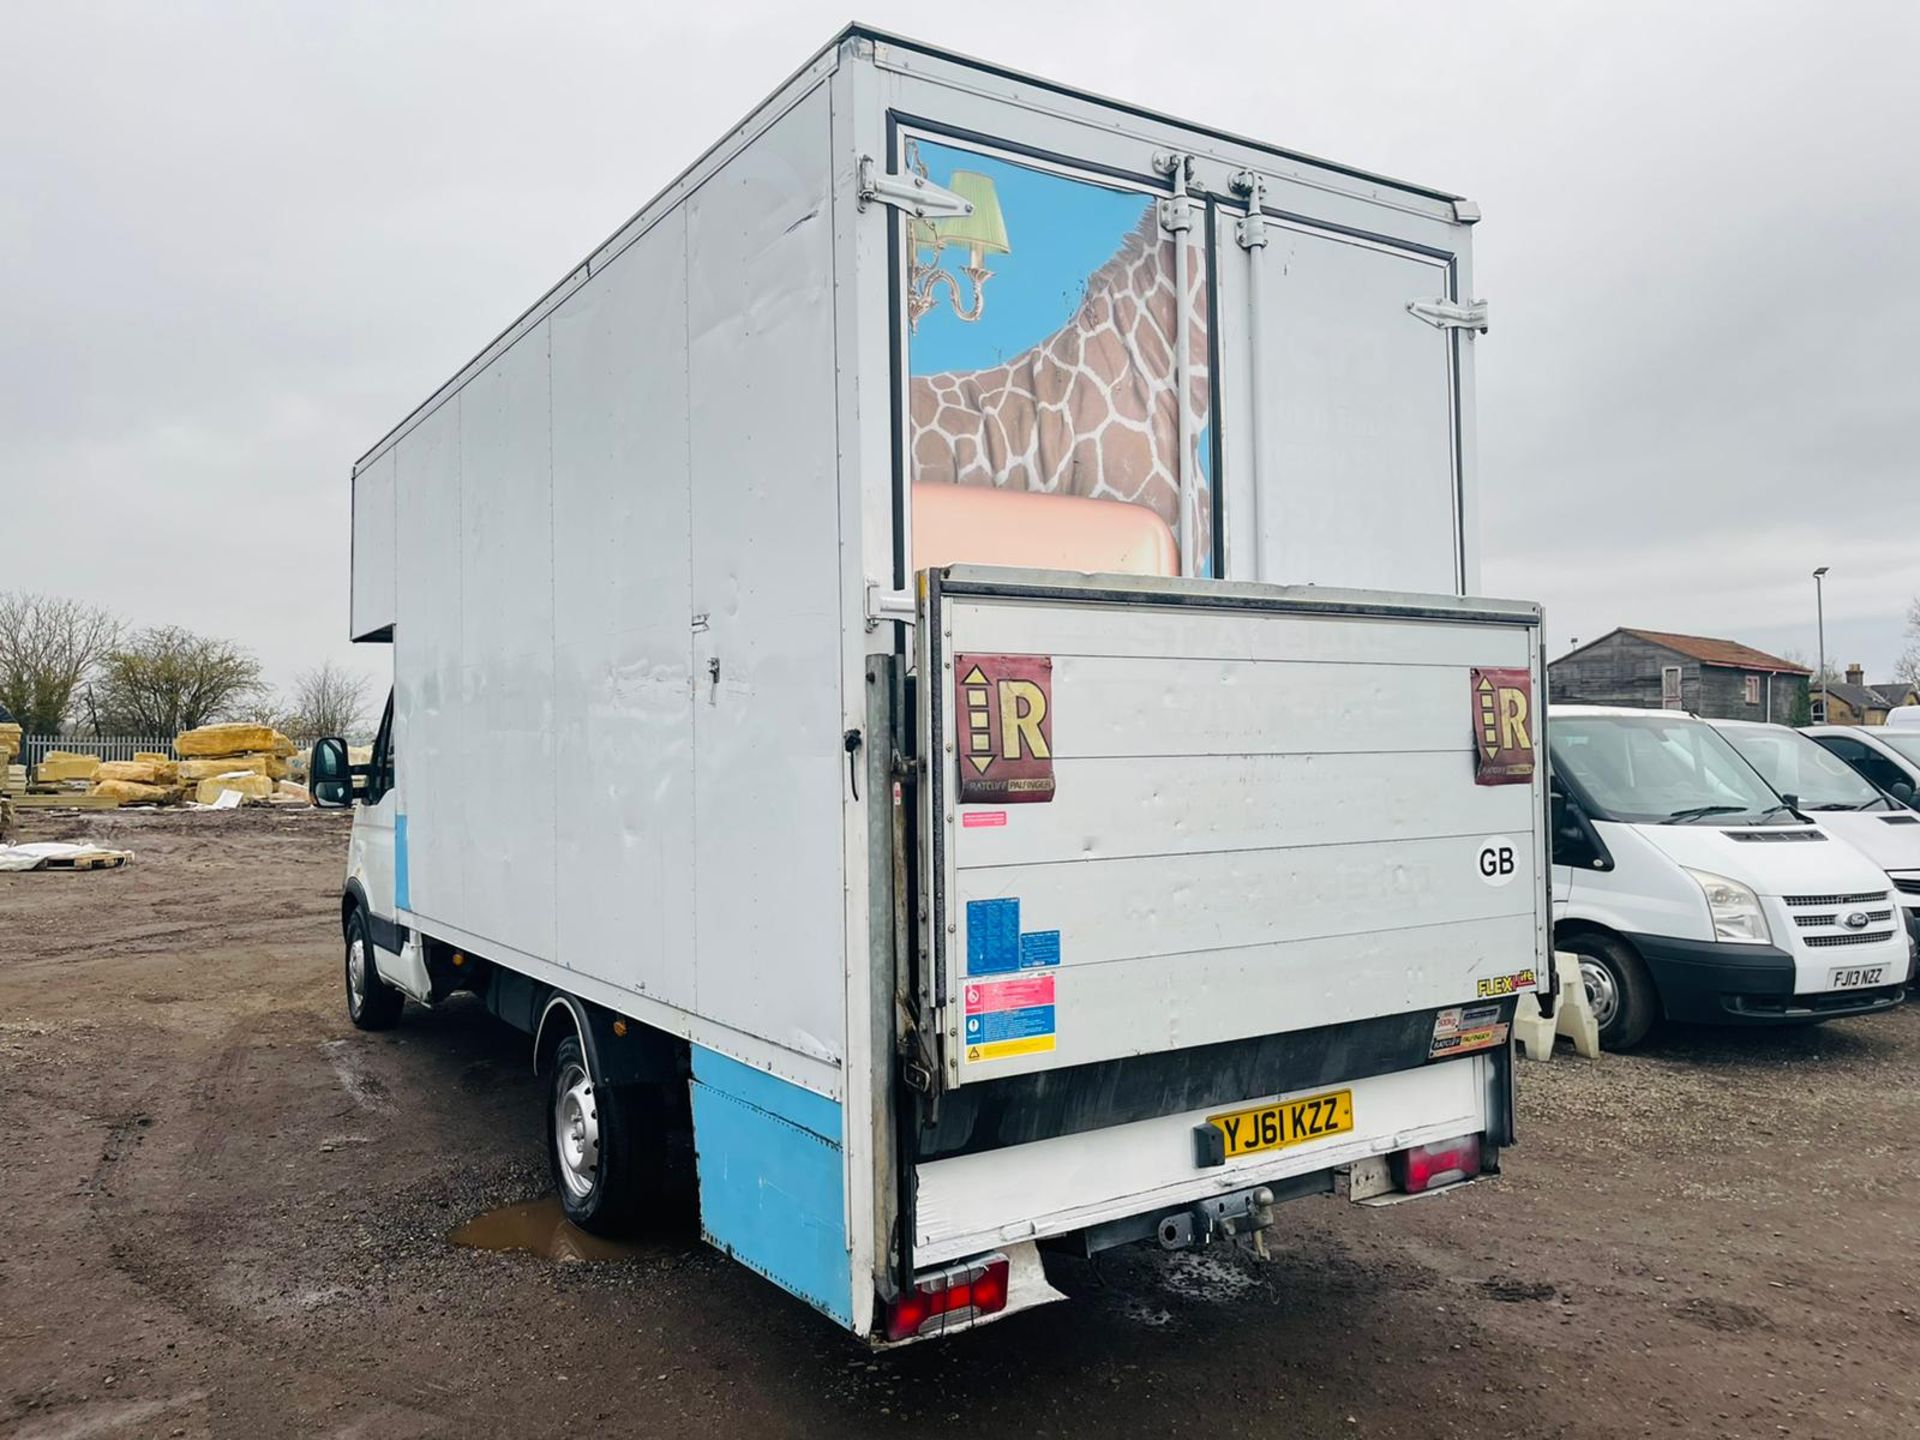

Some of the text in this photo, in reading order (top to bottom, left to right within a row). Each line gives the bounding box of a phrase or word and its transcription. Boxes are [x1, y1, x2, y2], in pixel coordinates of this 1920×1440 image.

[997, 679, 1051, 760] R
[1498, 686, 1532, 750] R
[1480, 847, 1514, 876] GB
[1833, 968, 1882, 987] FJ13 NZZ
[1224, 1098, 1338, 1151] YJ61 KZZ
